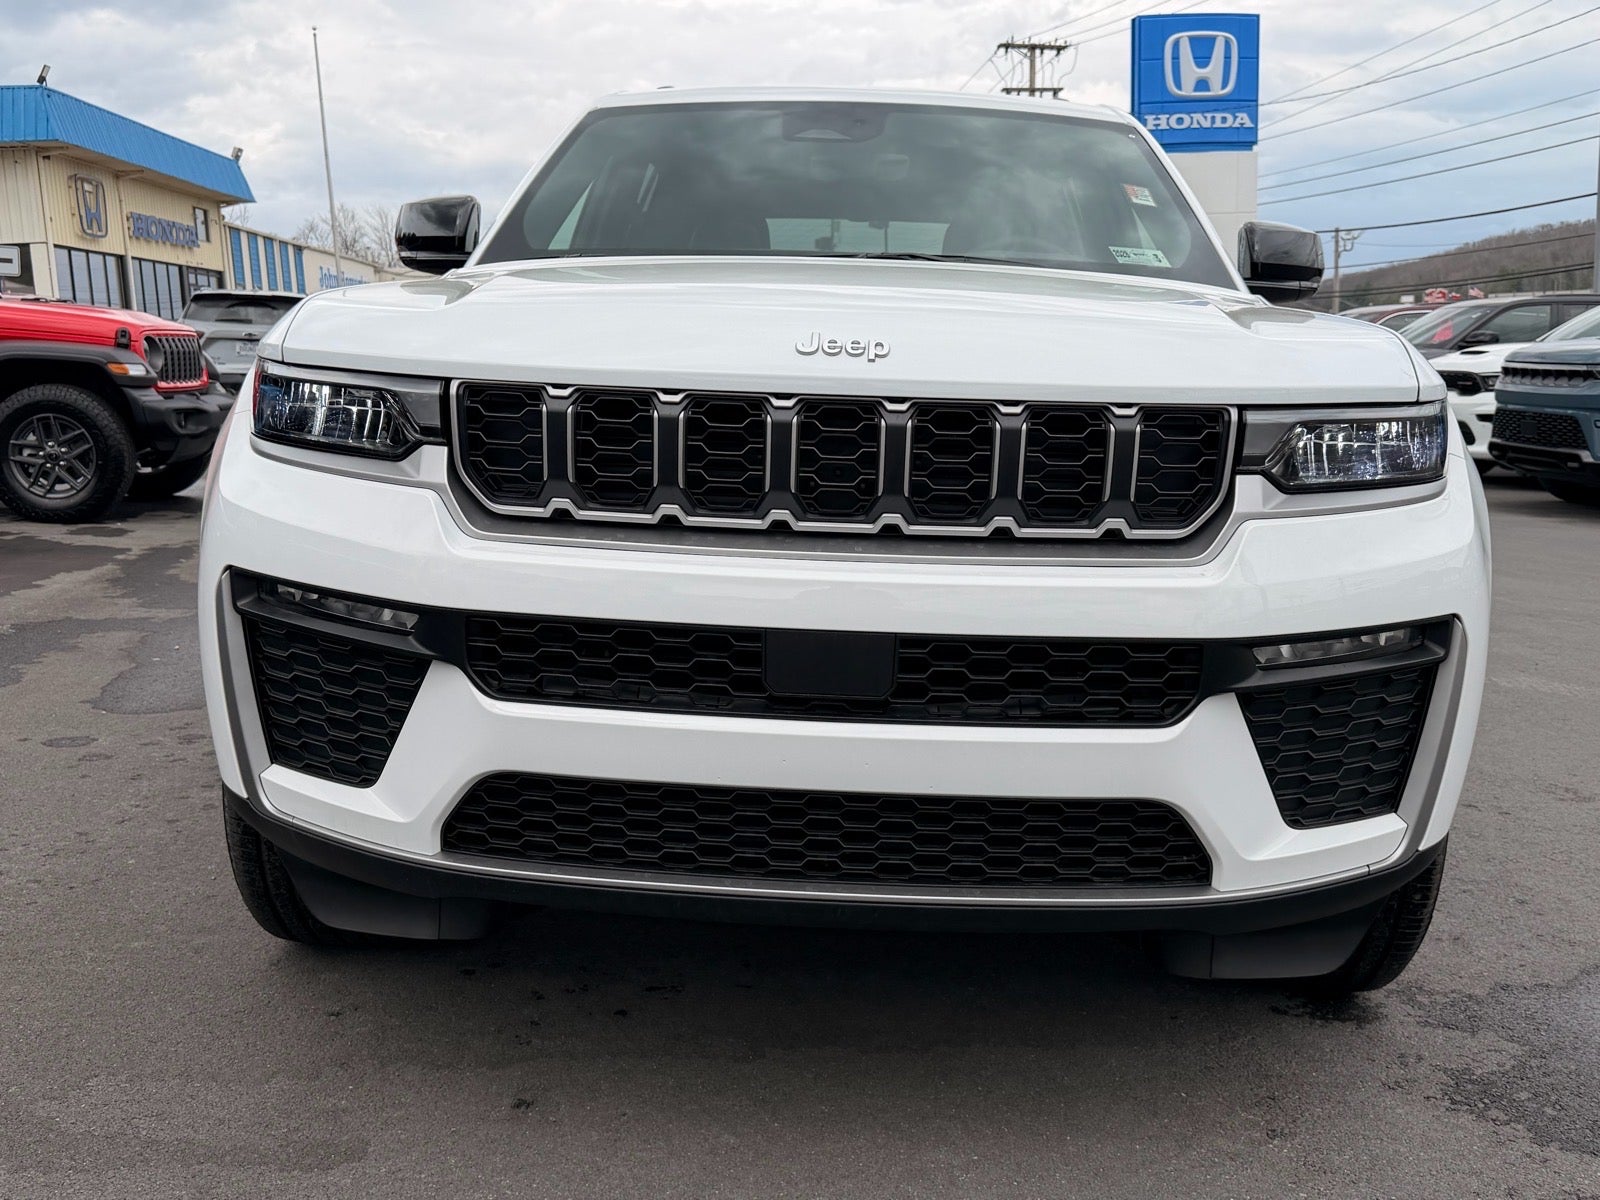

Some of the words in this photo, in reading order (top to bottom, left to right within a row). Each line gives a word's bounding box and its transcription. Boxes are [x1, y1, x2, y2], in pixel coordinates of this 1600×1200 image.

[1144, 112, 1255, 130] HONDA
[131, 211, 201, 248] HONDA
[795, 331, 890, 363] Jeep
